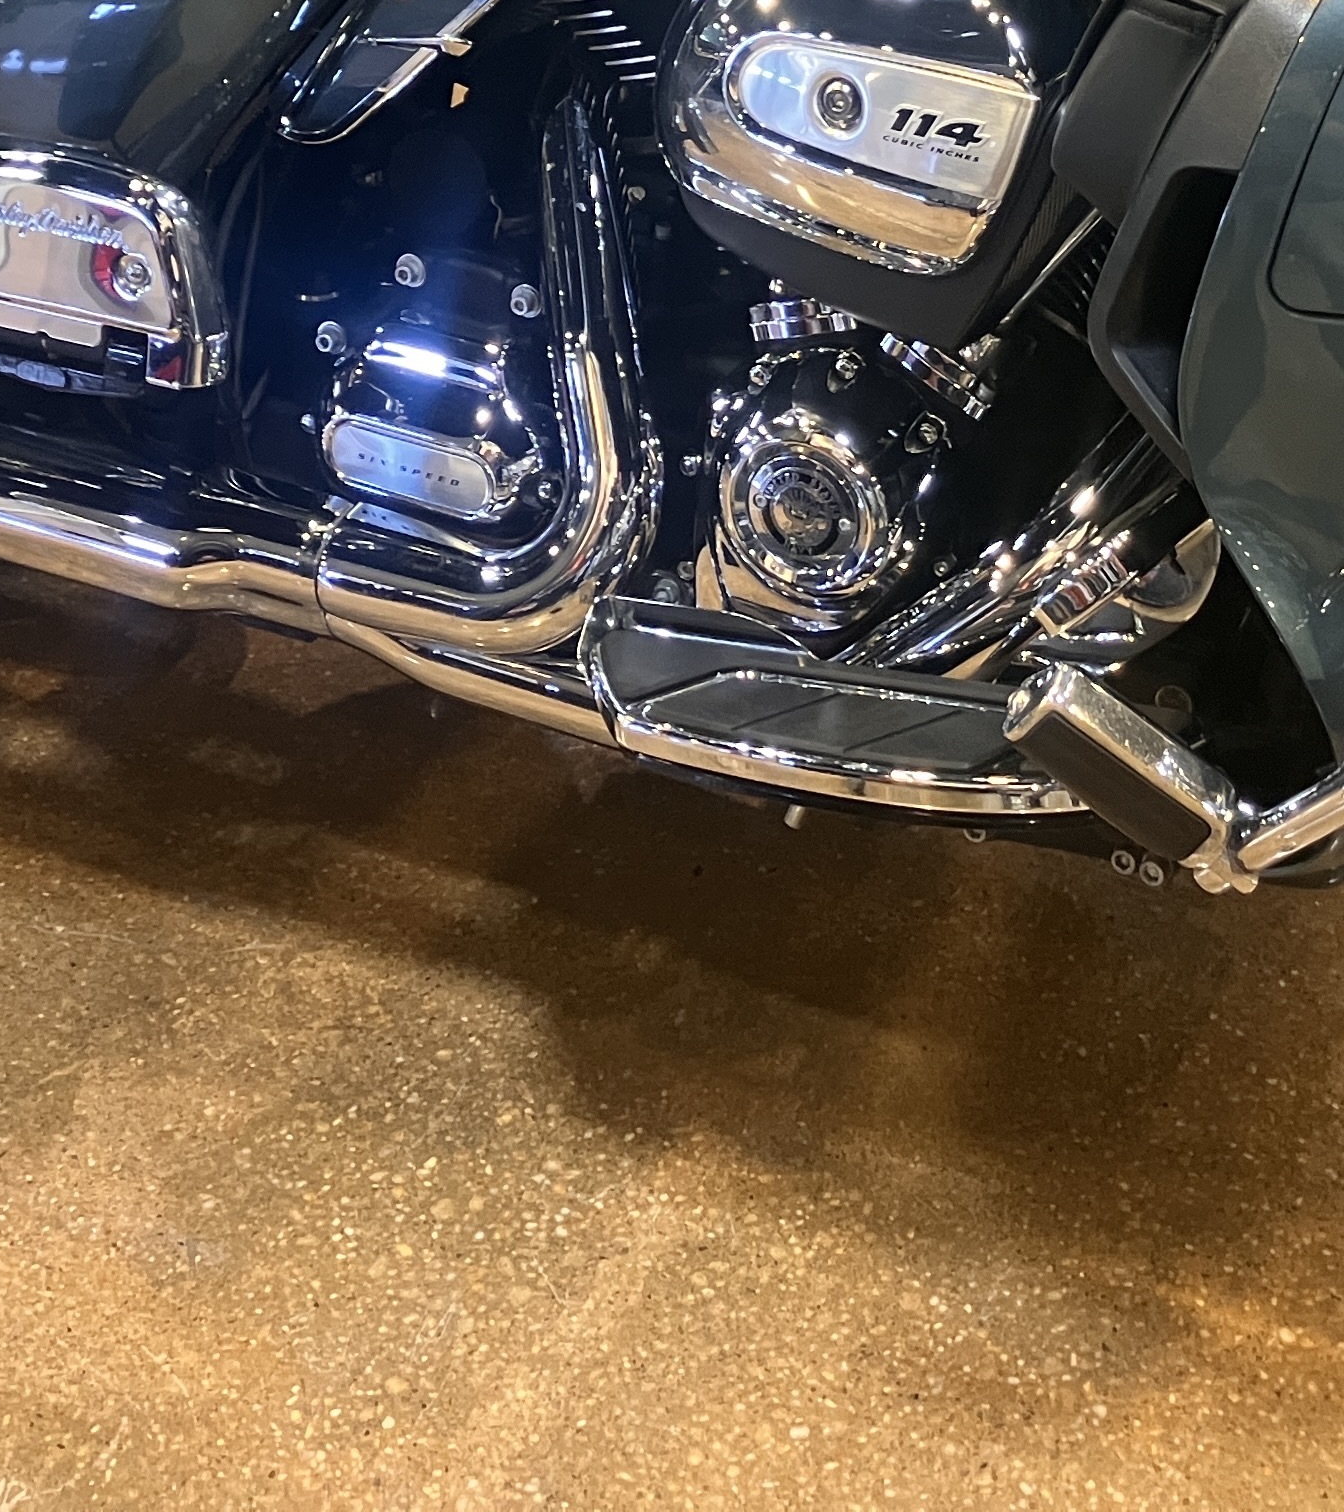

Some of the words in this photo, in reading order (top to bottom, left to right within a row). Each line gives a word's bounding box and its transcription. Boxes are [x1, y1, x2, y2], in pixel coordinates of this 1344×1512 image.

[889, 105, 988, 149] 114
[881, 134, 926, 150] CUBIC
[929, 145, 981, 163] INCHES
